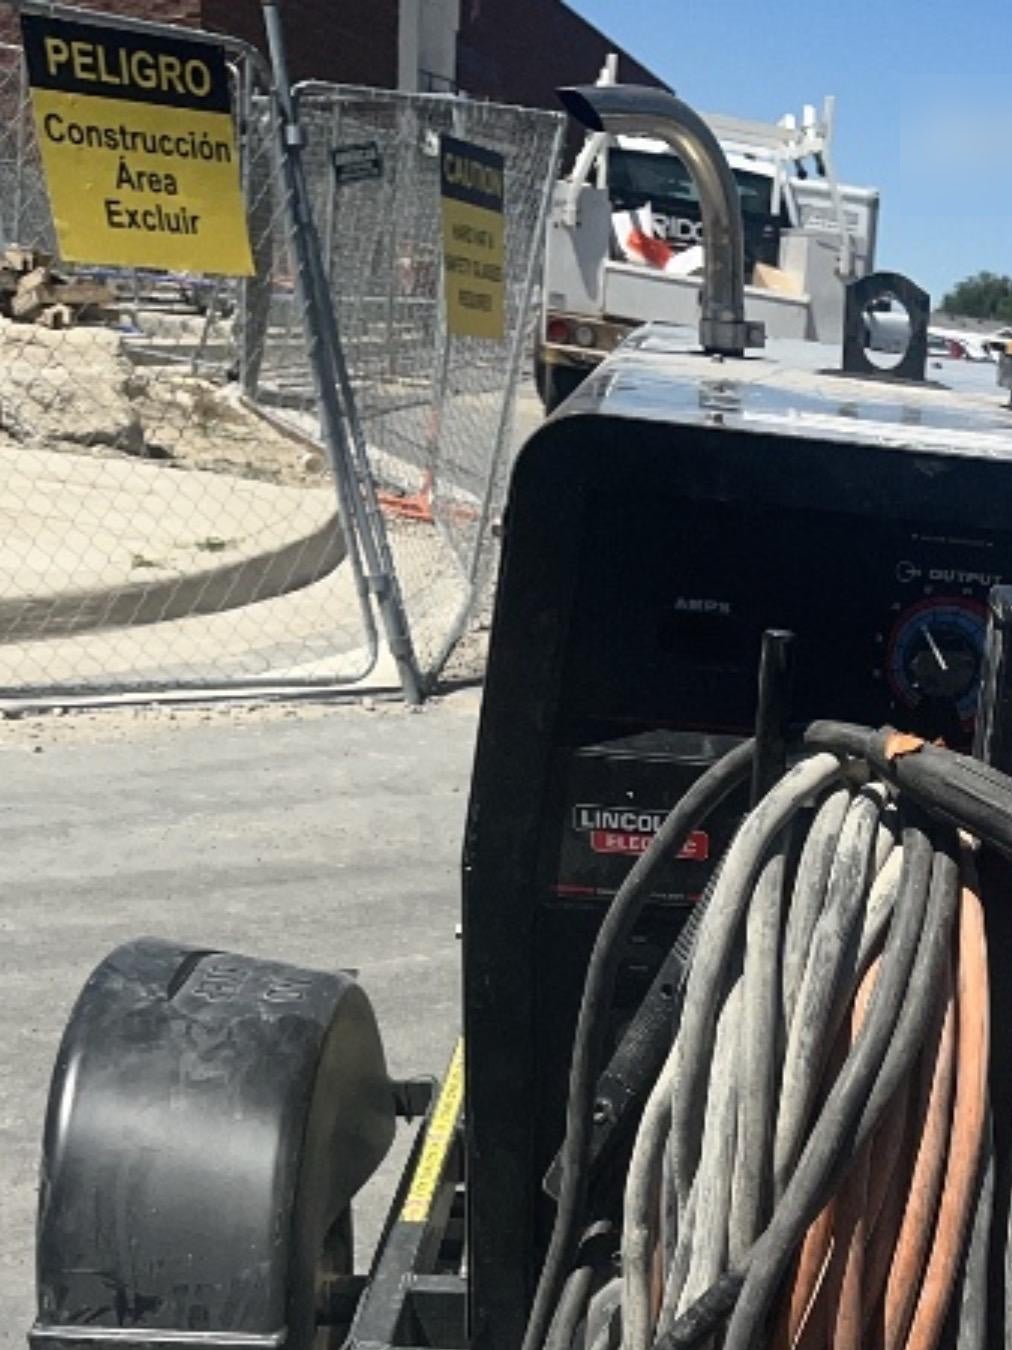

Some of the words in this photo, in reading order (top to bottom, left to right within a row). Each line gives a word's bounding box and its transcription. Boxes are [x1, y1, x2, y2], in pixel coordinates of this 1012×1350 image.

[43, 36, 213, 98] PELIGRO
[43, 112, 232, 163] Construcción
[115, 155, 178, 196] Área
[104, 198, 201, 235] Excluir
[928, 569, 1003, 586] OUTPUT
[673, 596, 732, 616] AMPS
[581, 808, 668, 833] LINCOL
